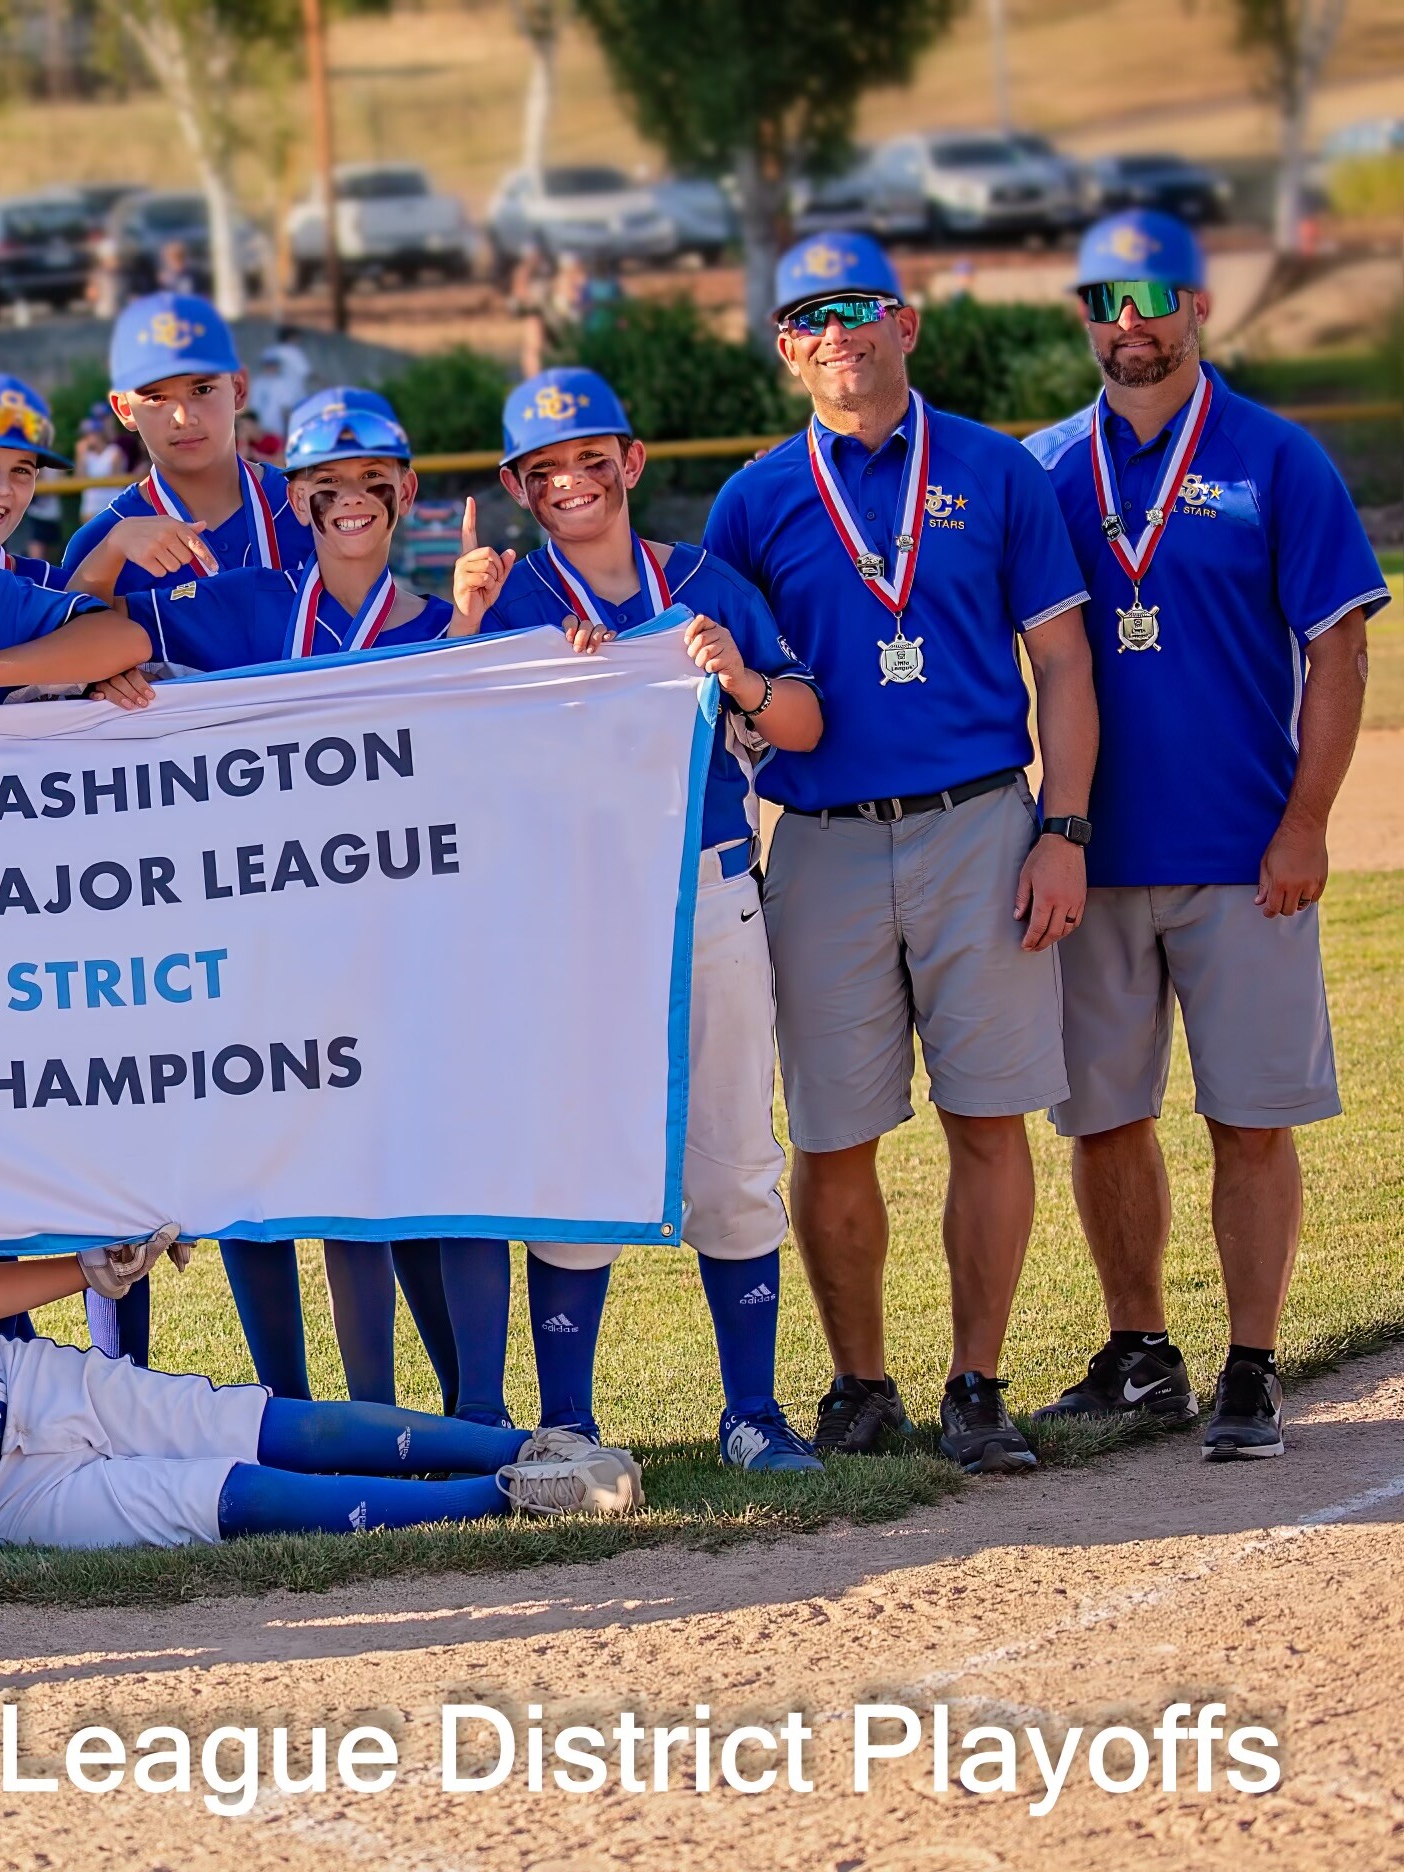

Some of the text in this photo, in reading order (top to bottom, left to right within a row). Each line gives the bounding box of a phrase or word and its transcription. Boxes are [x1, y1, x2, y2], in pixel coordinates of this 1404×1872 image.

[1183, 507, 1217, 519] STARS
[929, 519, 965, 530] STARS
[202, 823, 460, 900] LEAGUE
